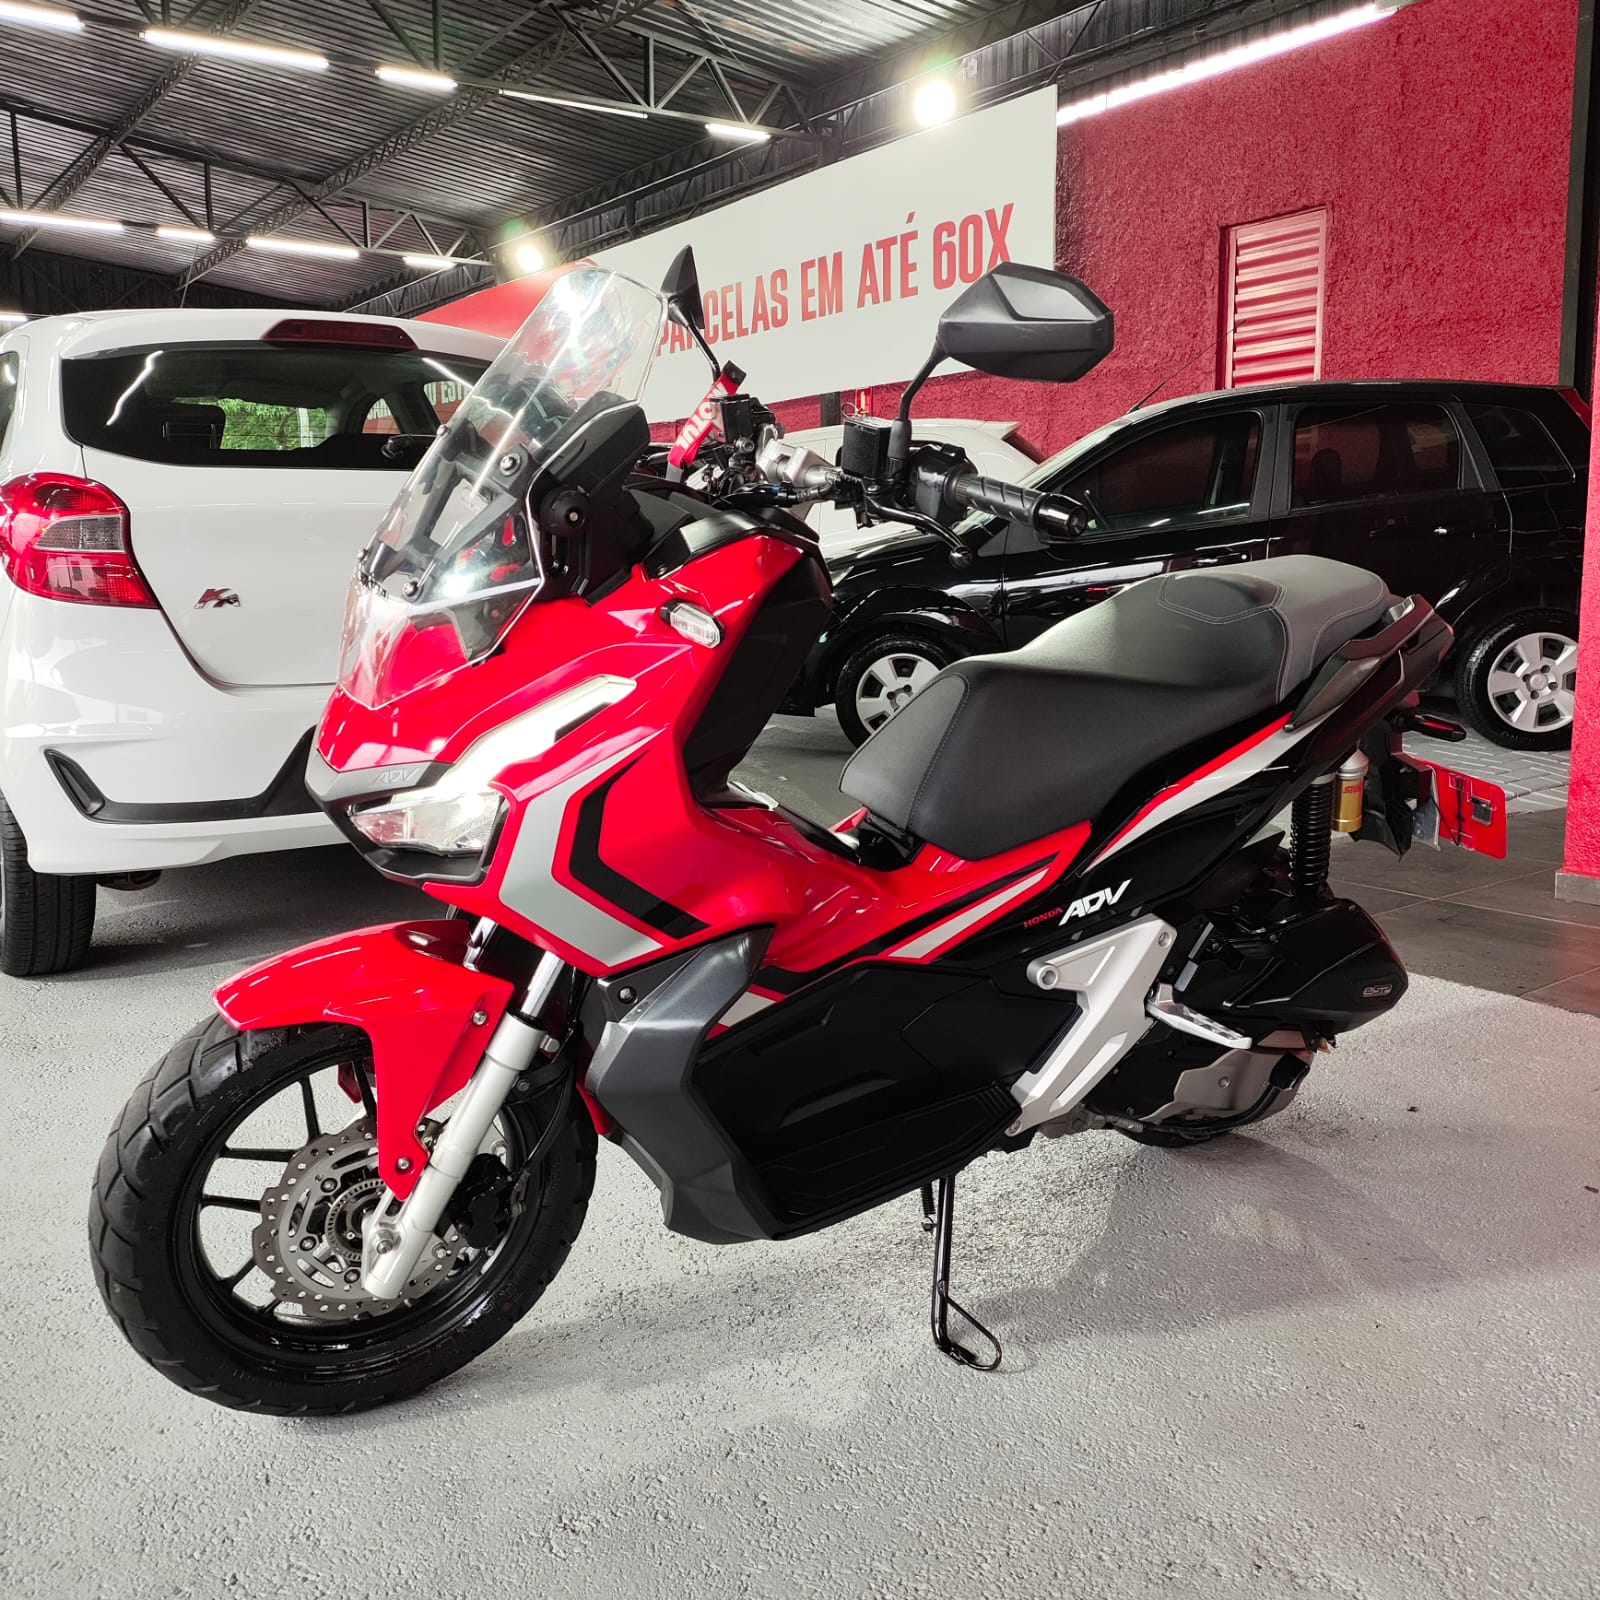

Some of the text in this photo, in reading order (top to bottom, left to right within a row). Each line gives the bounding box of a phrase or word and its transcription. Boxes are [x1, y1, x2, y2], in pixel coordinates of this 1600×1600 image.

[800, 251, 843, 322] EM
[856, 211, 919, 309] ATÉ
[933, 202, 1014, 290] 60X
[1023, 878, 1132, 928] HONDA ADV
